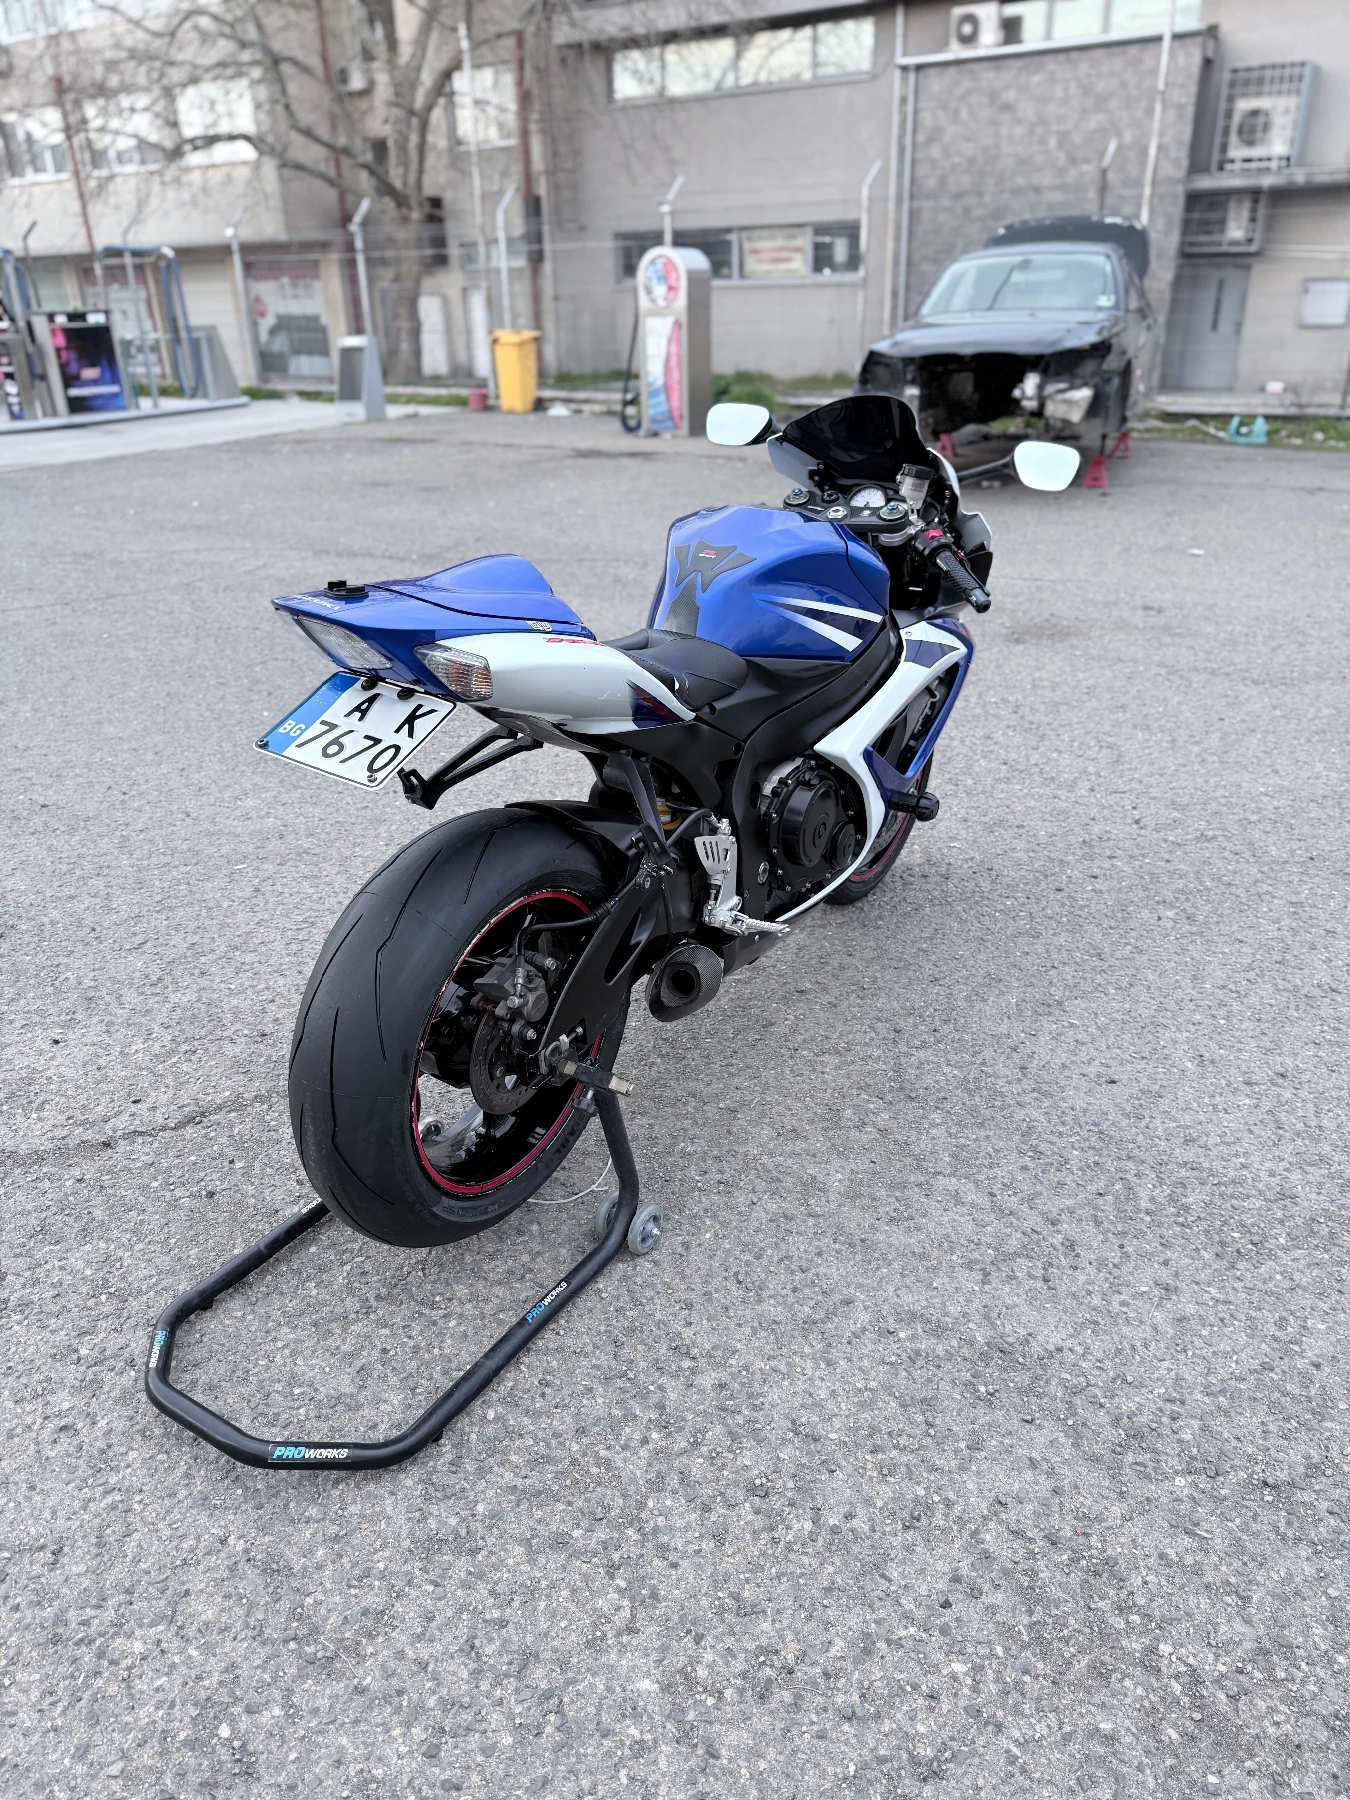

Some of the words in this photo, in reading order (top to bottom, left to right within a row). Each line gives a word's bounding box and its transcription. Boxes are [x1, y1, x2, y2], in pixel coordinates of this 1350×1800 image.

[277, 719, 306, 737] BG
[343, 692, 384, 723] A
[393, 703, 439, 740] K
[295, 719, 402, 775] 7670
[524, 1280, 568, 1324] PROWORKS
[272, 1446, 349, 1459] PROWORKS
